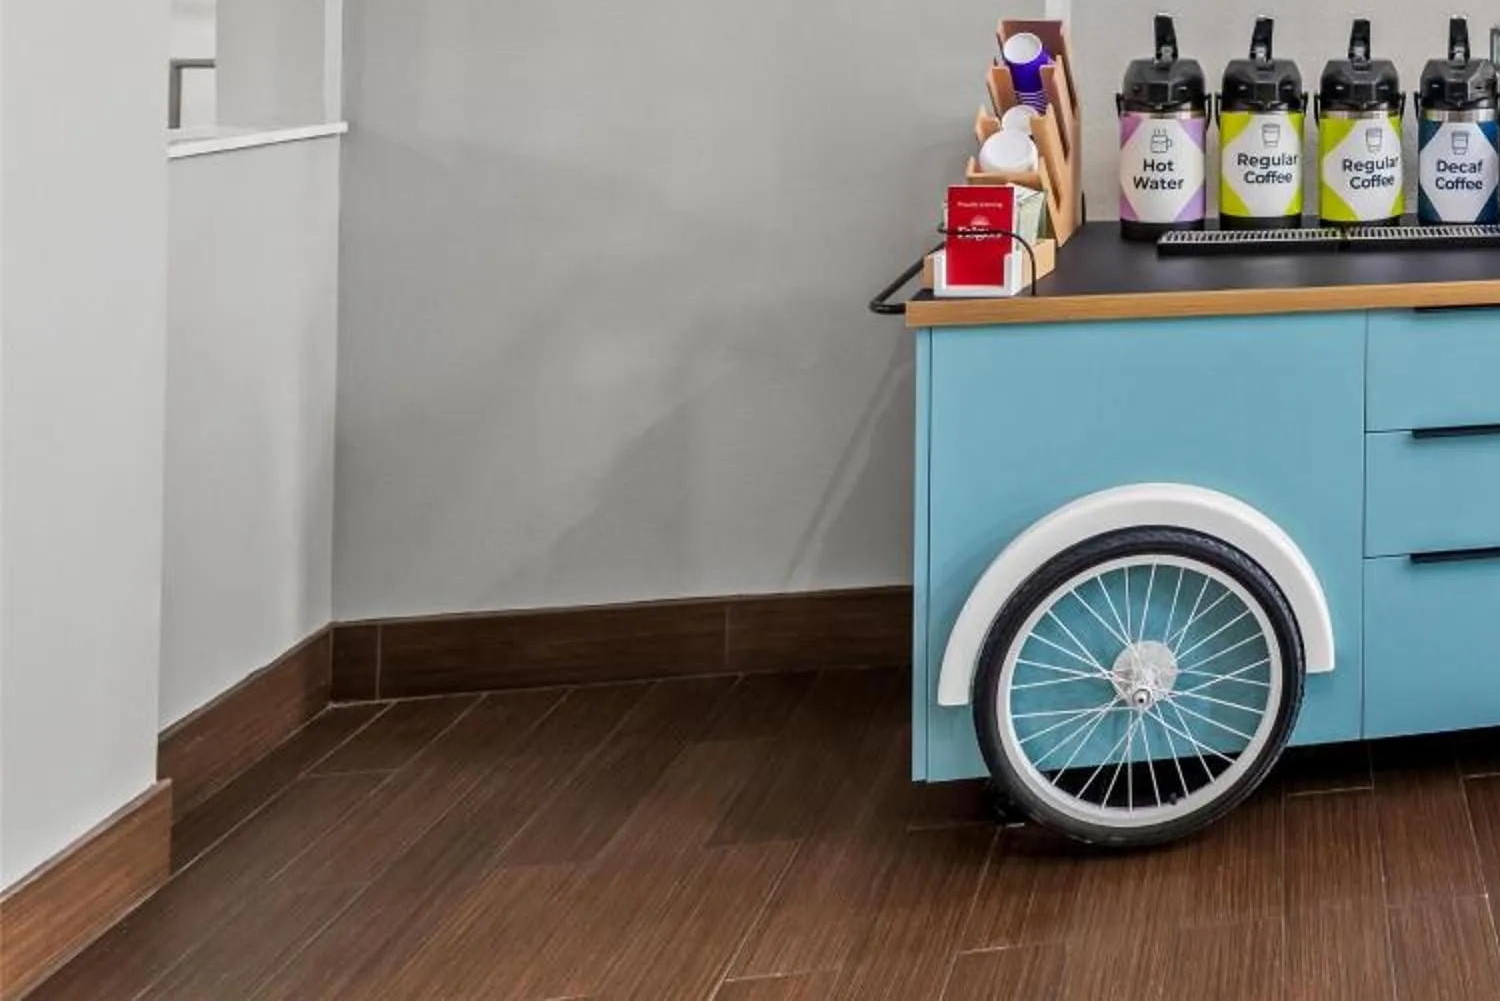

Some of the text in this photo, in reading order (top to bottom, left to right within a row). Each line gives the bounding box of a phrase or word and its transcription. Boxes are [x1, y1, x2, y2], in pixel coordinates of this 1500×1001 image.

[1143, 158, 1174, 172] Hot
[1237, 152, 1298, 169] Regular
[1436, 159, 1483, 173] Decaf
[1133, 176, 1184, 190] Water
[1244, 170, 1293, 184] Coffee
[1350, 174, 1395, 190] Coffee
[1435, 176, 1483, 190] Coffee
